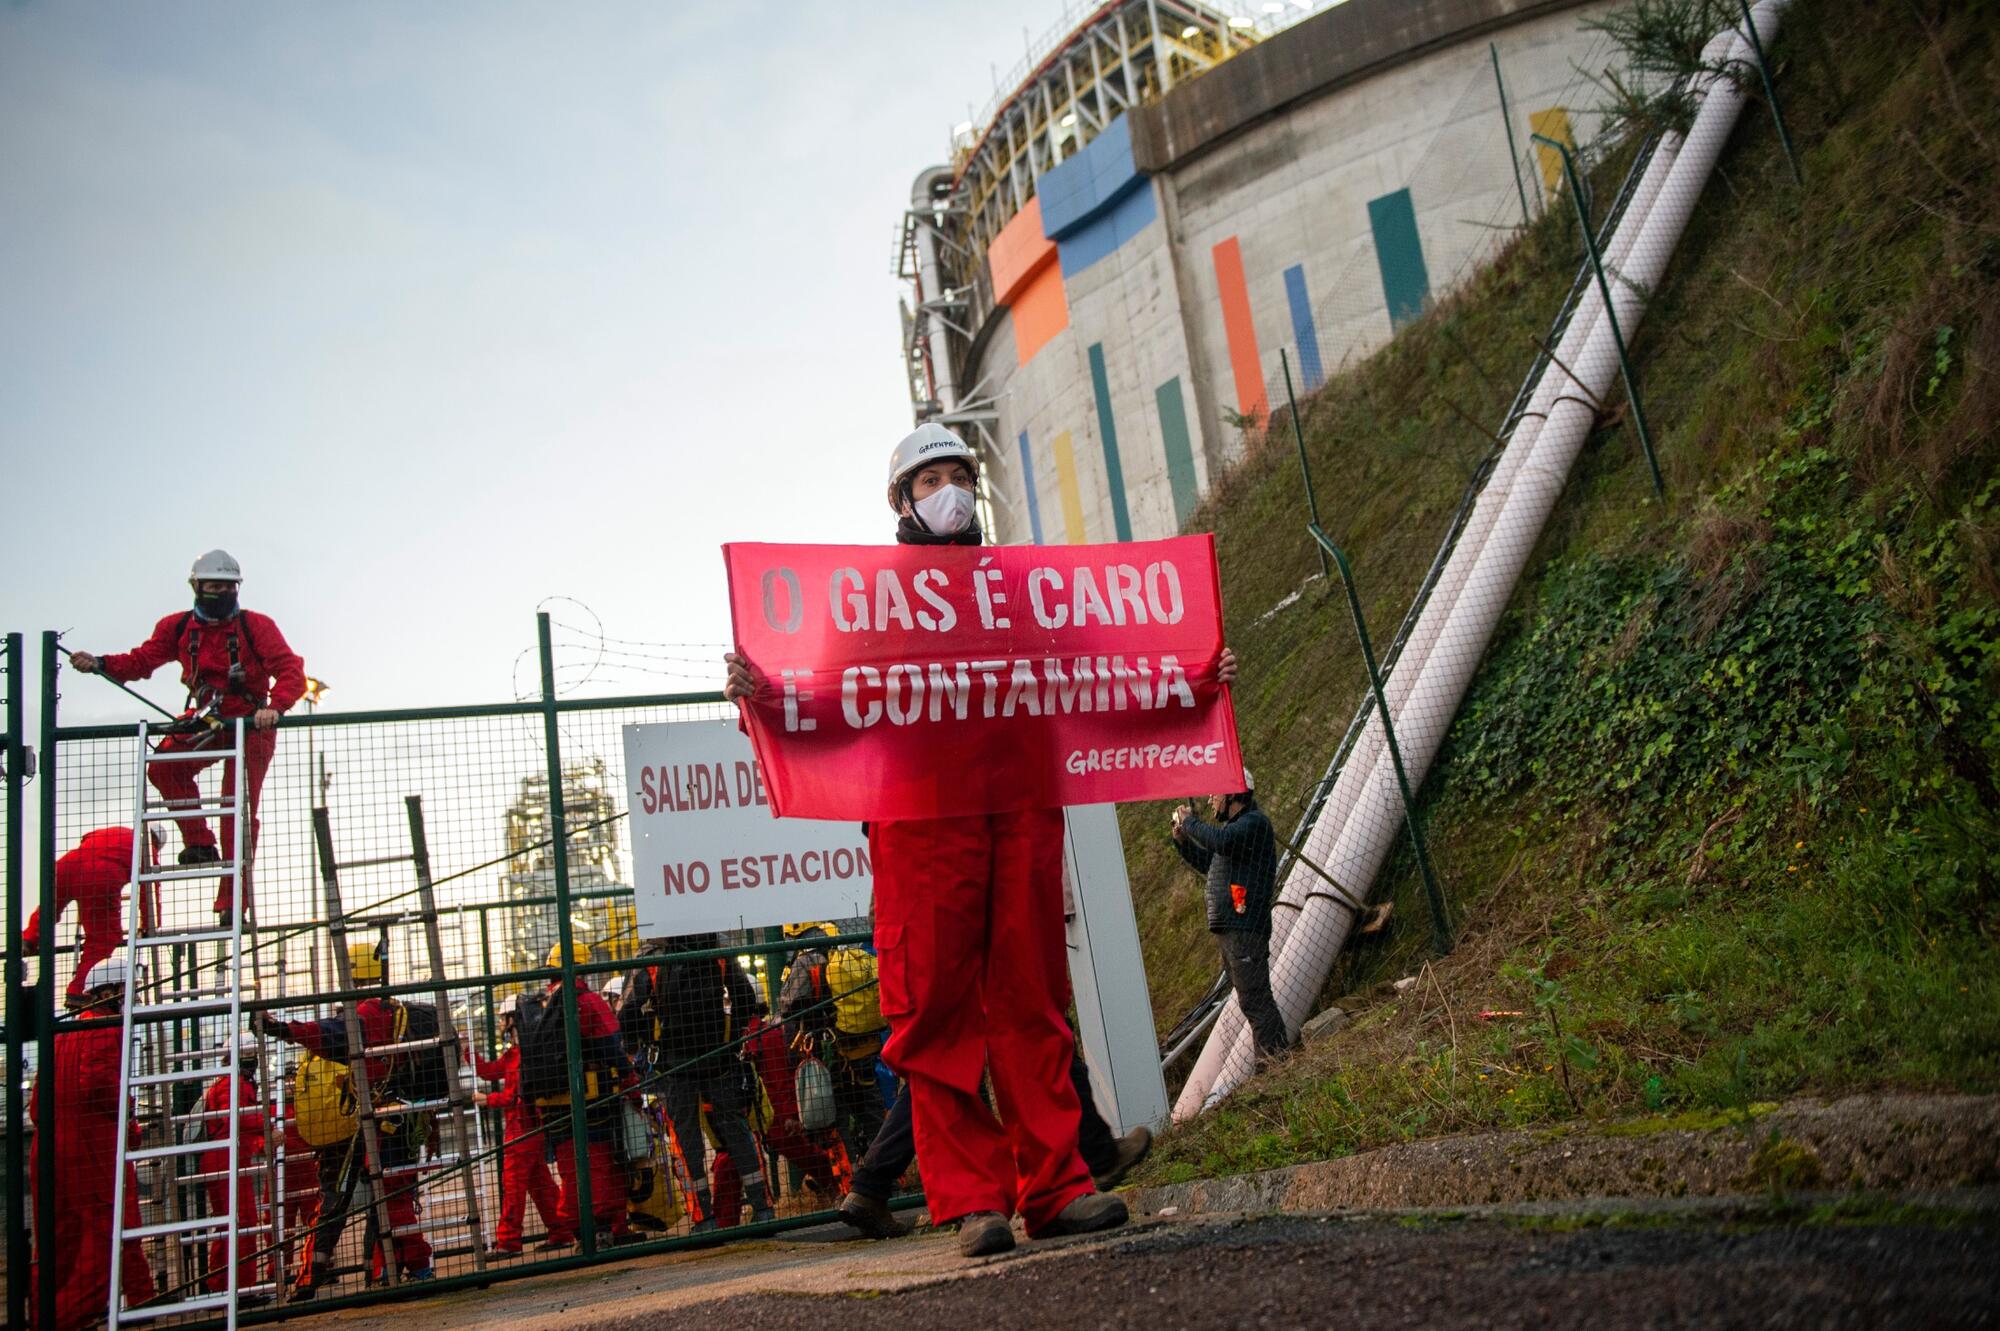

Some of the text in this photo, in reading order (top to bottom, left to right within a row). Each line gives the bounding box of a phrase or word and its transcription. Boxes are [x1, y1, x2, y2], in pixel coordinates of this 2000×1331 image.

[918, 441, 964, 454] GREENPE
[762, 556, 1185, 634] O GAS É CARO
[780, 655, 1197, 733] E CONTAMINA
[1065, 742, 1225, 776] GREENPEACE
[640, 762, 731, 816] SALIDA
[662, 860, 711, 896] NO
